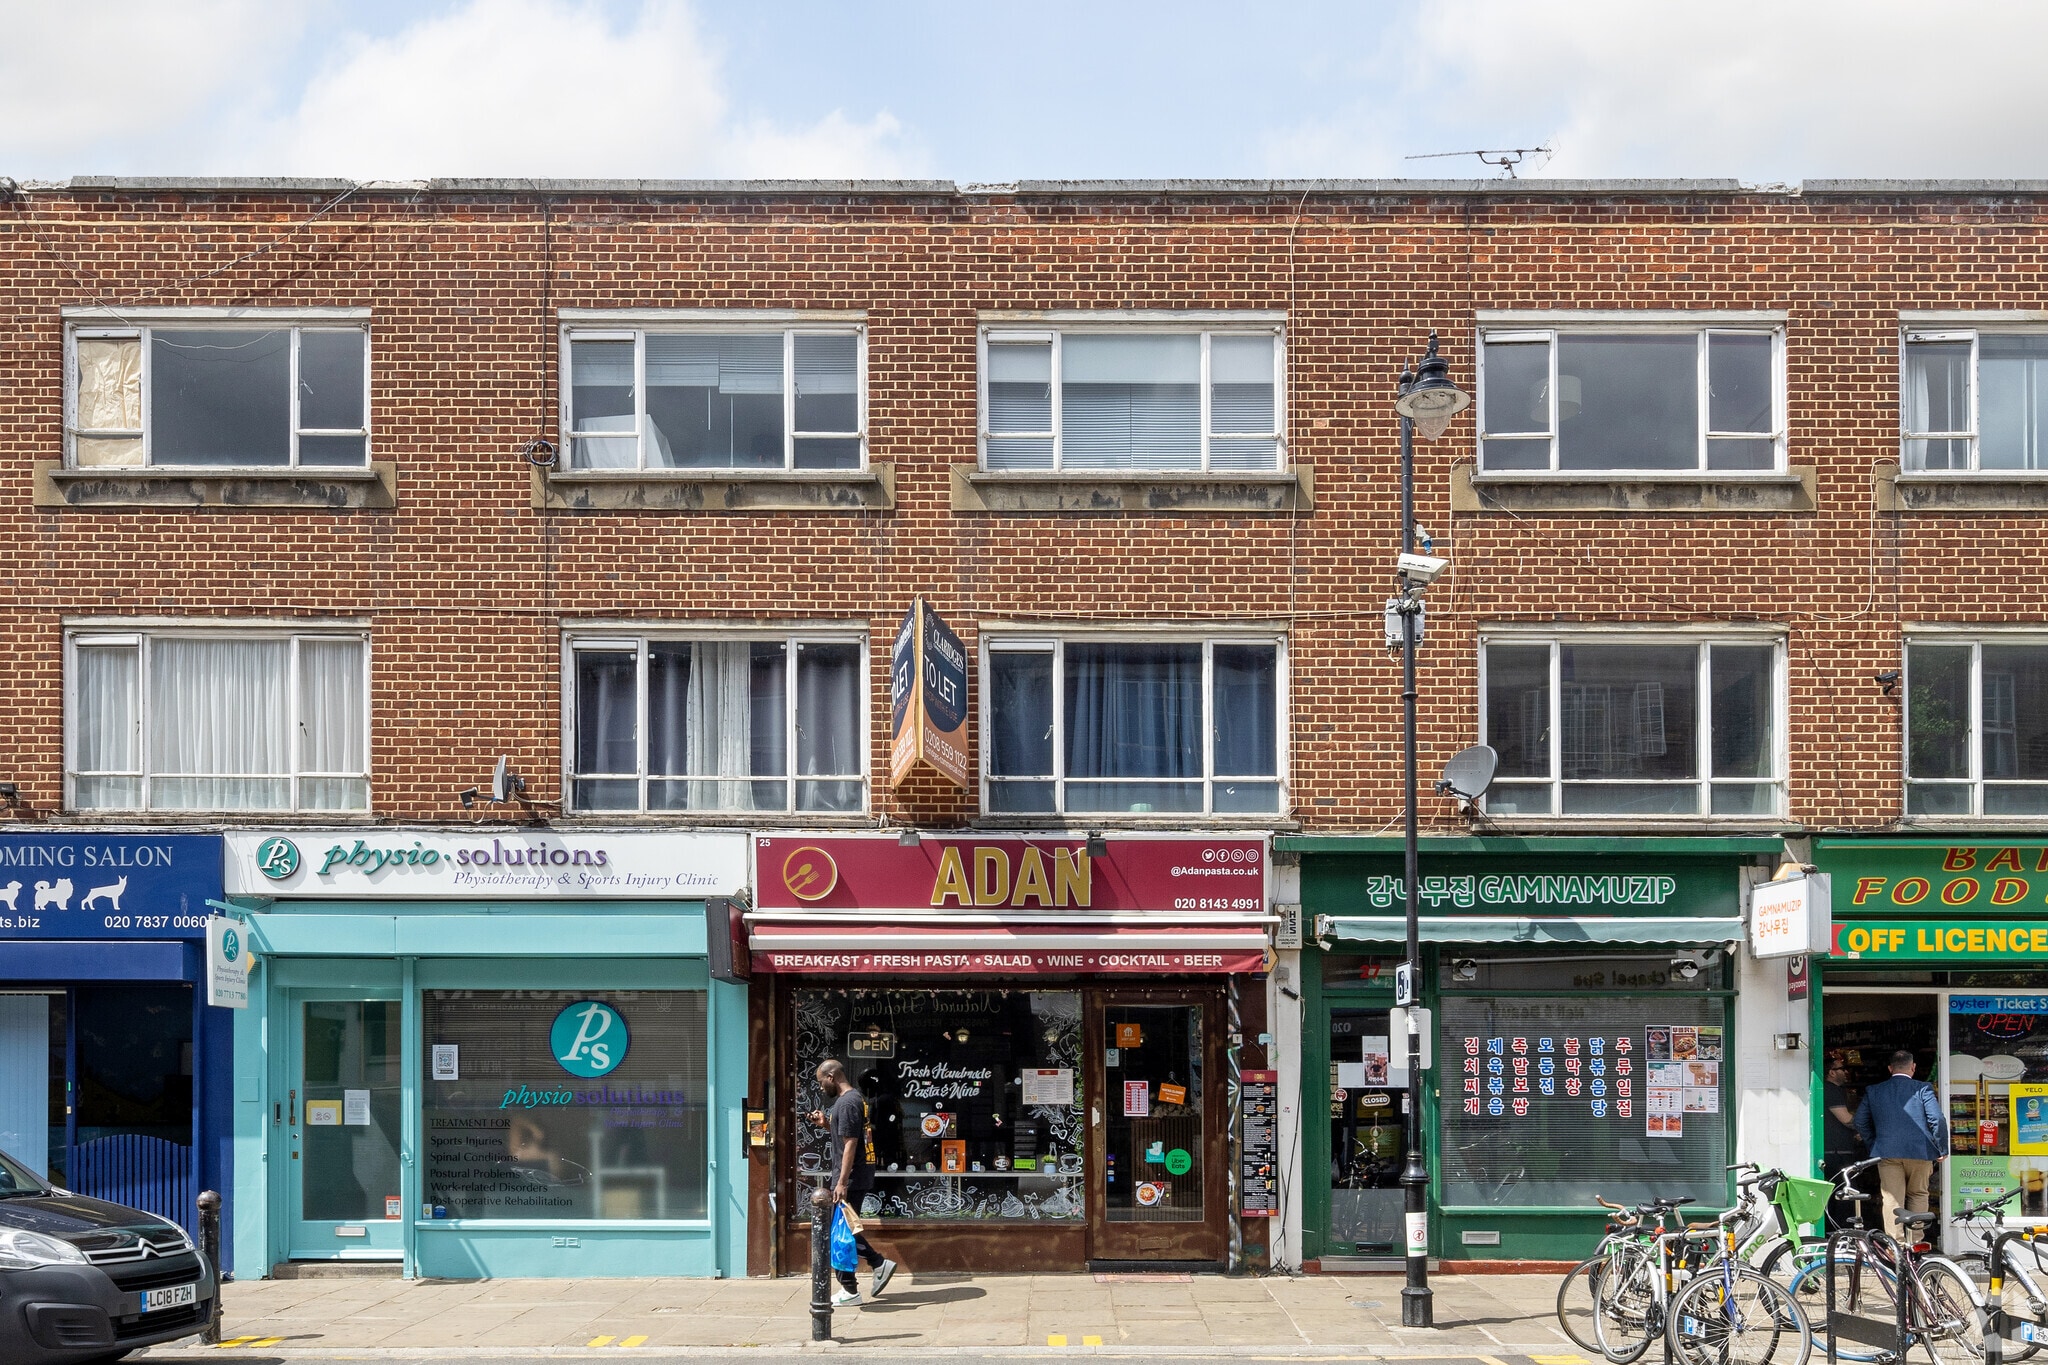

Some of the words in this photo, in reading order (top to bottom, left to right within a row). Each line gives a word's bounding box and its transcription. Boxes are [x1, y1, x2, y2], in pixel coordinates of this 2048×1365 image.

[896, 660, 909, 694] LET
[924, 654, 937, 688] TO
[938, 672, 957, 706] LET
[924, 726, 940, 752] 0208
[954, 749, 967, 771] 1122
[759, 838, 771, 847] 25
[0, 846, 75, 867] MING
[84, 846, 173, 867] SALON
[317, 840, 439, 875] physio
[457, 839, 607, 866] solutions
[453, 871, 553, 889] Physiotherapy
[558, 872, 571, 885] &
[577, 871, 621, 889] Sports
[625, 872, 671, 889] Injury
[675, 871, 719, 886] Clinic
[930, 846, 1092, 906] ADAN
[1170, 866, 1259, 877] @Adanpasta.co.uk
[1479, 875, 1676, 905] GAMNAMUZIP
[1853, 876, 2048, 906] FOOD
[1174, 898, 1196, 909] 020
[1199, 898, 1228, 909] 8143
[1231, 898, 1260, 909] 4991
[1759, 899, 1801, 917] GAMNAMUZIP
[104, 916, 130, 928] 020
[135, 916, 168, 928] 7837
[173, 916, 207, 928] 0060
[1848, 928, 1906, 953] OFF
[774, 955, 860, 967] BREAKFAST
[873, 955, 921, 967] FRESH
[925, 955, 970, 967] PASTA
[984, 955, 1032, 967] SALAD
[1047, 955, 1083, 967] WINE
[1099, 954, 1169, 967] COCKTAIL
[1184, 954, 1222, 966] BEER
[1359, 964, 1381, 979] 27
[1950, 999, 1991, 1010] oyster
[1995, 997, 2037, 1010] Ticket
[2040, 998, 2048, 1010] S
[1977, 1013, 2035, 1031] OPEN
[853, 1040, 890, 1051] OPEN
[898, 1059, 931, 1079] Fresh
[931, 1062, 992, 1079] Handmade
[1538, 1037, 1554, 1095] 모둠전
[1564, 1037, 1581, 1096] 불막창
[1464, 1037, 1480, 1115] 김치찌개
[1487, 1037, 1504, 1115] 제육볶음
[1511, 1037, 1529, 1115] 족발보쌈
[1589, 1037, 1607, 1117] 닭볶음탕
[499, 1084, 572, 1109] physio
[576, 1085, 684, 1105] solutions
[904, 1079, 940, 1098] Pasta
[949, 1081, 980, 1099] Wine
[1363, 1096, 1388, 1104] CLOSED
[430, 1118, 487, 1127] TREATMENT
[490, 1118, 511, 1127] FOR
[430, 1136, 462, 1147] Sports
[466, 1136, 503, 1147] Injuries
[430, 1152, 461, 1163] Spinal
[464, 1152, 519, 1162] Conditions
[1973, 1157, 1993, 1166] Wine
[430, 1168, 470, 1179] Postural
[473, 1168, 521, 1179] Problems
[1960, 1168, 1977, 1179] Soft
[1980, 1169, 2006, 1178] Drinks
[430, 1182, 496, 1192] Work-related
[500, 1182, 548, 1192] Disorders
[430, 1195, 502, 1206] Post-operative
[504, 1195, 573, 1206] Rehabilitation
[1740, 1234, 1766, 1261] ime
[150, 1290, 172, 1307] LC18
[174, 1285, 192, 1303] FZH
[2024, 1325, 2032, 1338] P
